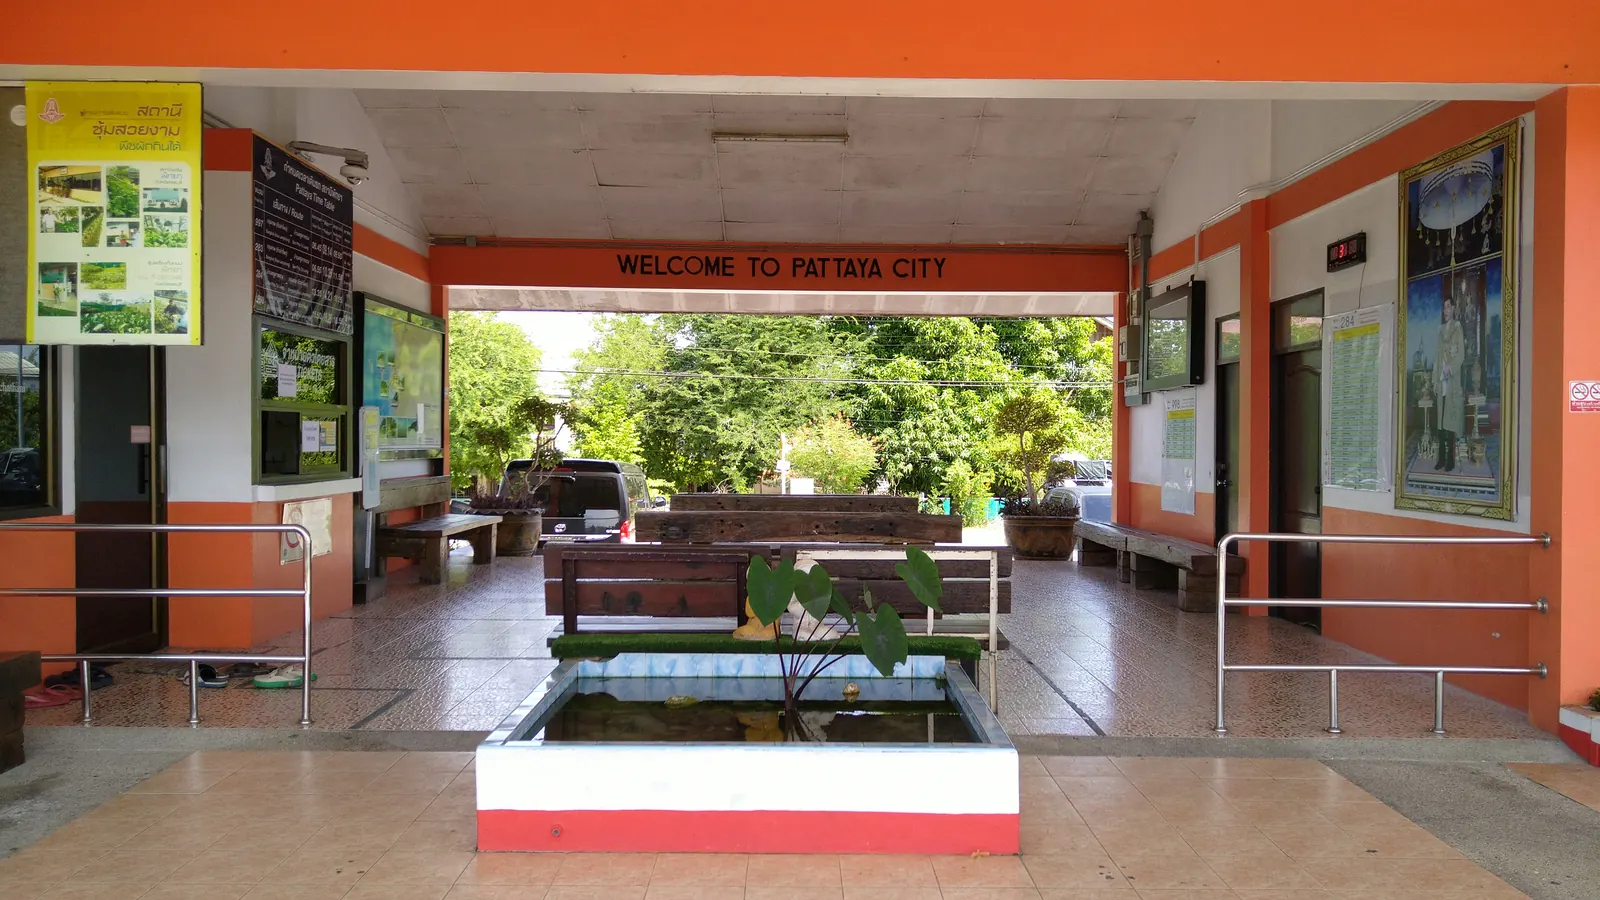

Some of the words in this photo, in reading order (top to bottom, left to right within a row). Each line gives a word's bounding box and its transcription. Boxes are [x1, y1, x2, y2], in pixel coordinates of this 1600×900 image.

[137, 103, 183, 117] สถานี
[295, 183, 313, 201] Pattaya
[312, 192, 324, 206] Time
[323, 197, 336, 212] Table
[291, 207, 304, 220] Route
[616, 254, 735, 277] WELCOME
[747, 256, 781, 278] TO
[791, 257, 883, 279] PATTAYA
[892, 258, 947, 279] CITY
[1340, 315, 1355, 329] 284
